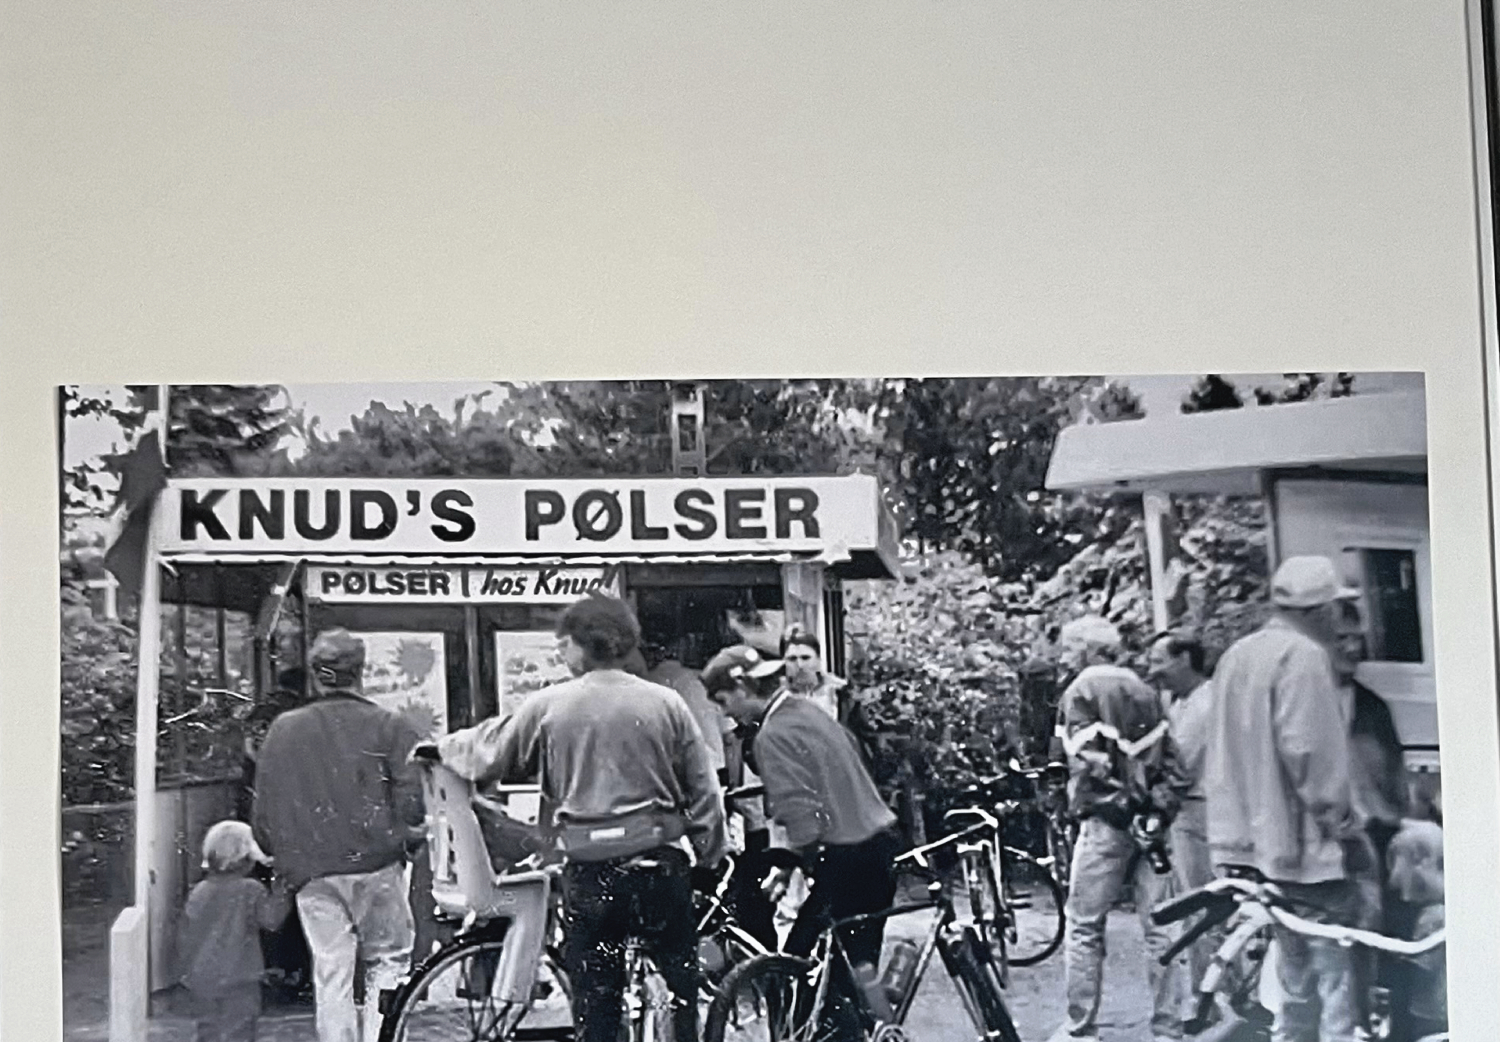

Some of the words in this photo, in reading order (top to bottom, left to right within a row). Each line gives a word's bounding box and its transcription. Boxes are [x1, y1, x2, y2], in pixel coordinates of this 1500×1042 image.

[180, 488, 477, 542] KNUD'S
[525, 487, 821, 541] PØLSER
[480, 568, 527, 596] hos
